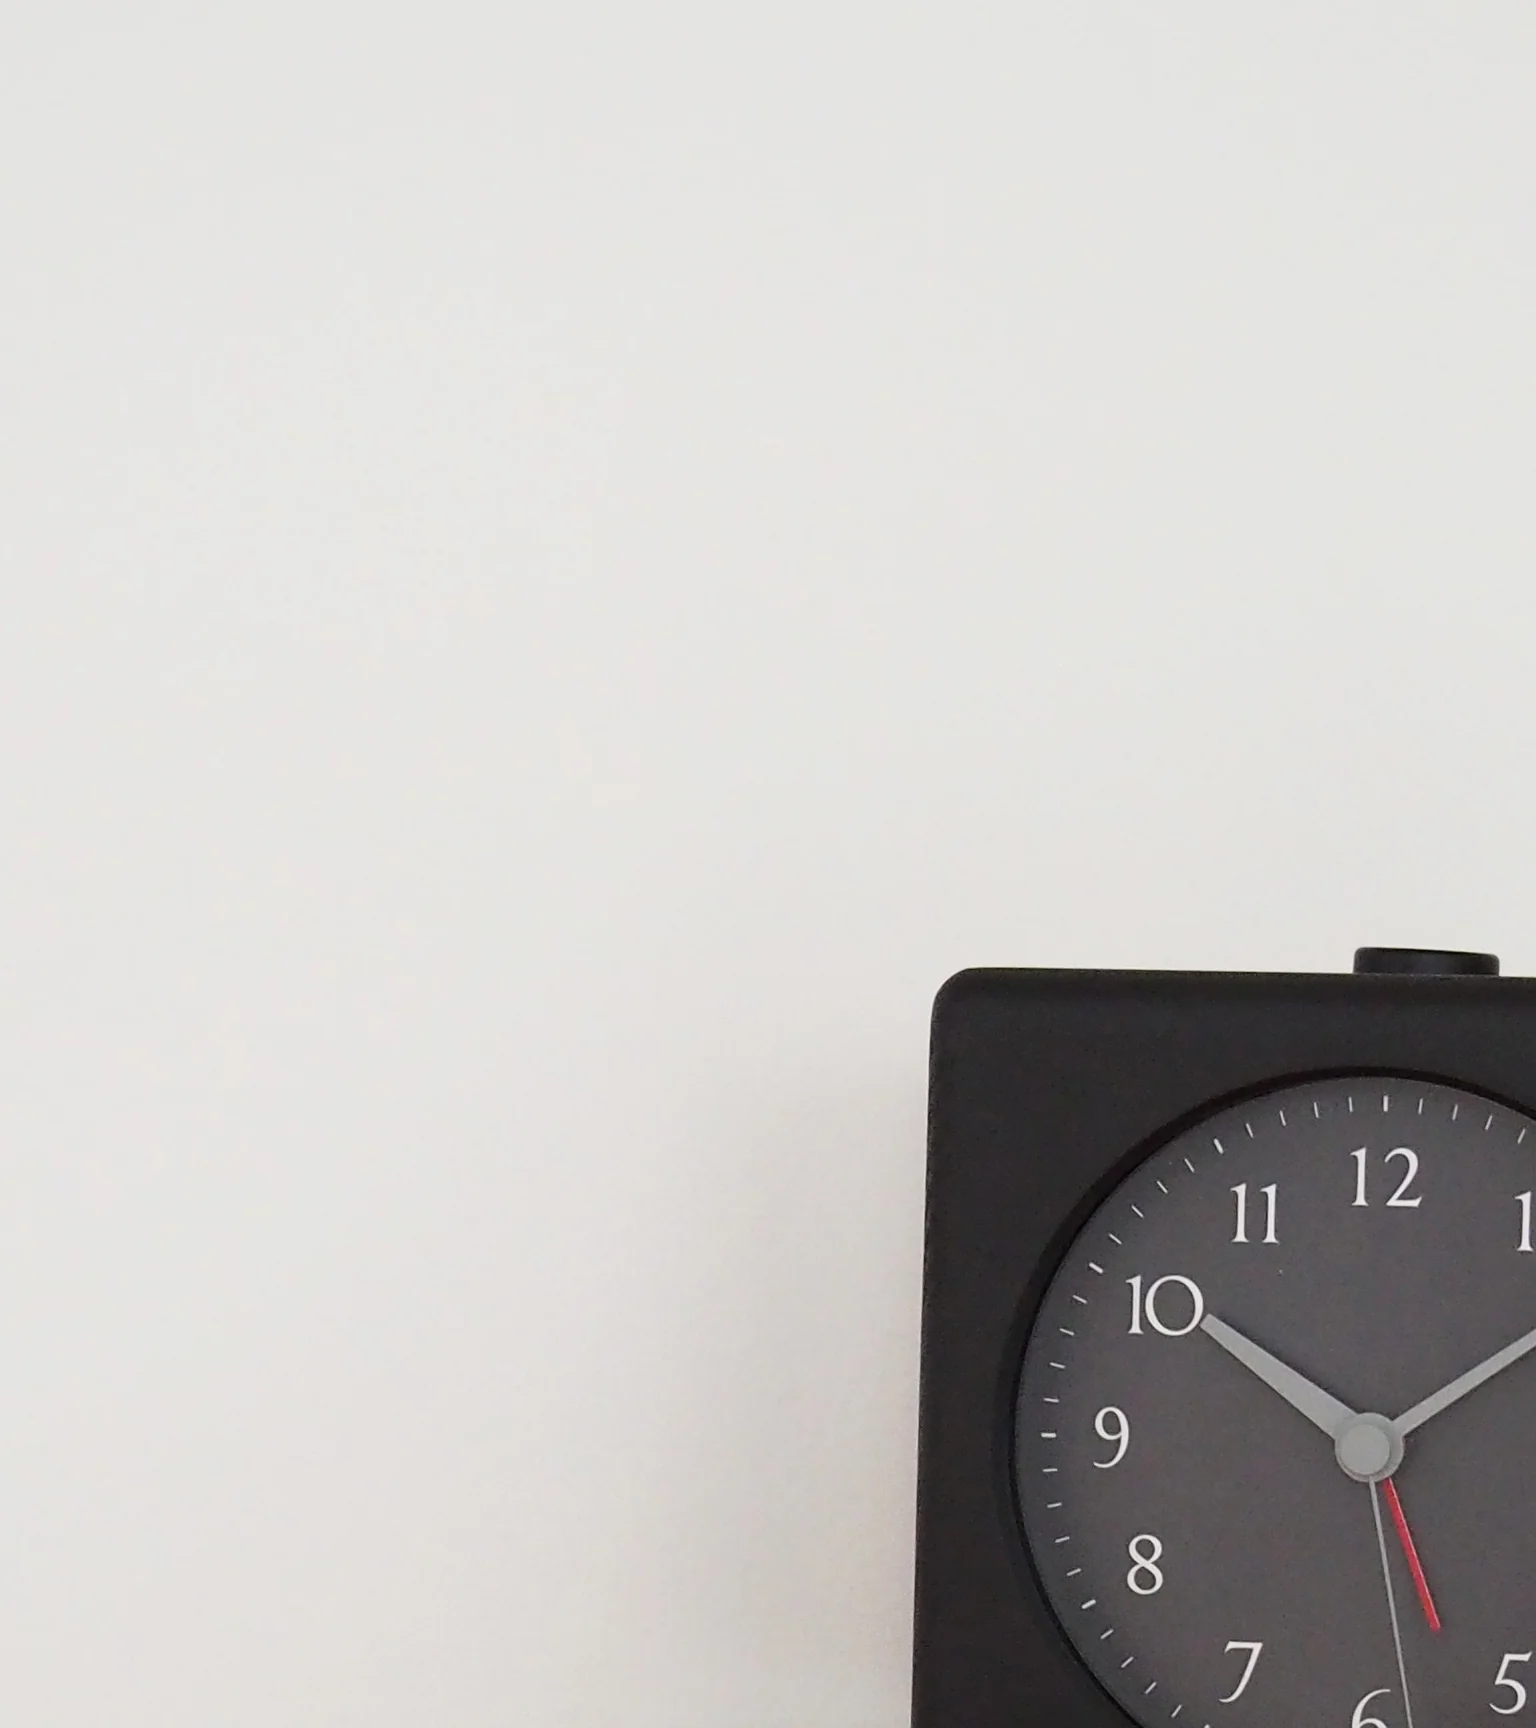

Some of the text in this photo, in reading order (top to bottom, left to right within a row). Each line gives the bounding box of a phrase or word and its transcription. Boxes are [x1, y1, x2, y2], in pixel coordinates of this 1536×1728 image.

[1350, 1147, 1423, 1208] 12
[1230, 1184, 1280, 1244] 11
[1514, 1191, 1535, 1252] 1
[1125, 1274, 1204, 1336] 10
[1092, 1406, 1131, 1468] 9
[1125, 1534, 1164, 1595] 8
[1218, 1641, 1264, 1703] 7
[1489, 1651, 1533, 1714] 5
